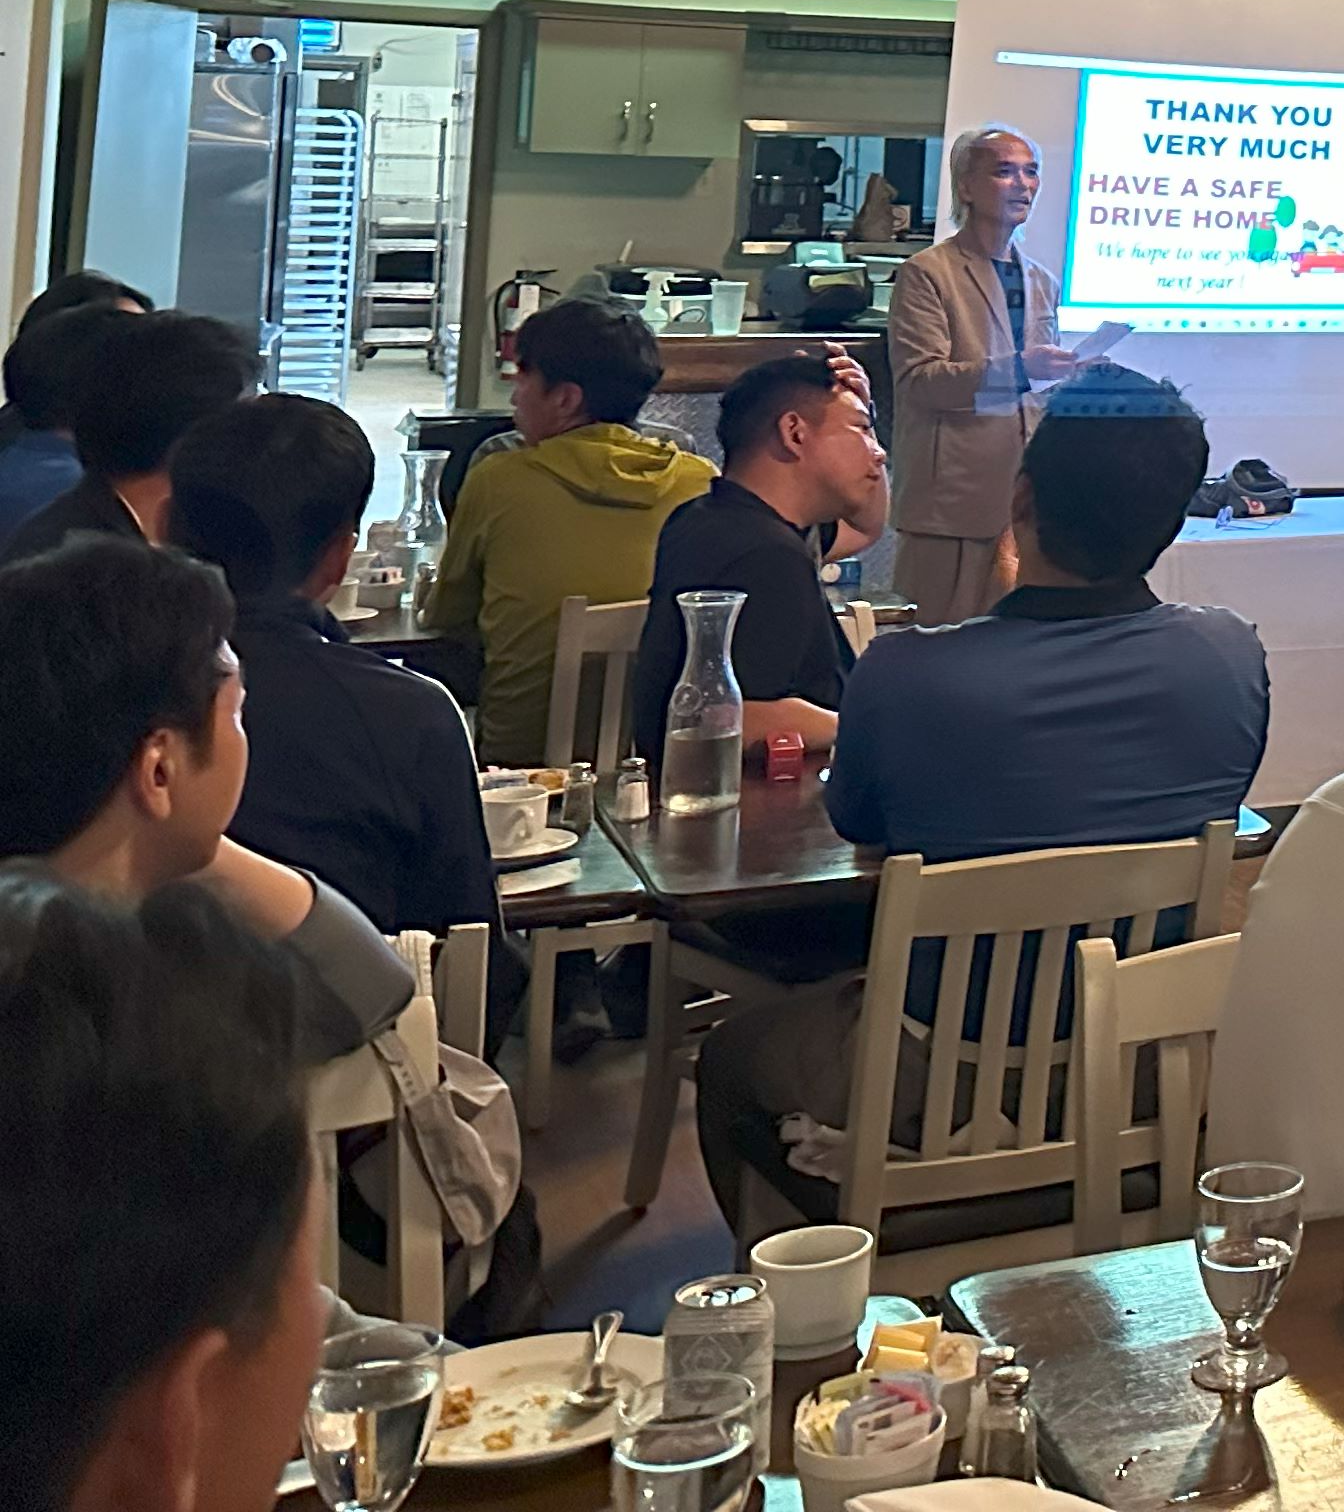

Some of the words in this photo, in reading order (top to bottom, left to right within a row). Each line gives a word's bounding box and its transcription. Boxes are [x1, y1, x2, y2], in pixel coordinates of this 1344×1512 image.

[1146, 99, 1258, 124] THANK
[1271, 105, 1332, 126] YOU
[1143, 133, 1228, 156] VERY
[1240, 138, 1330, 160] MUCH
[1088, 173, 1170, 196] HAVE
[1180, 178, 1199, 196] A
[1210, 179, 1283, 199] SAFE
[1089, 206, 1182, 228] DRIVE
[1193, 209, 1275, 230] HOME
[1098, 242, 1125, 258] We
[1131, 242, 1170, 265] hope
[1176, 247, 1193, 259] to
[1200, 250, 1222, 260] see
[1157, 276, 1193, 289] next
